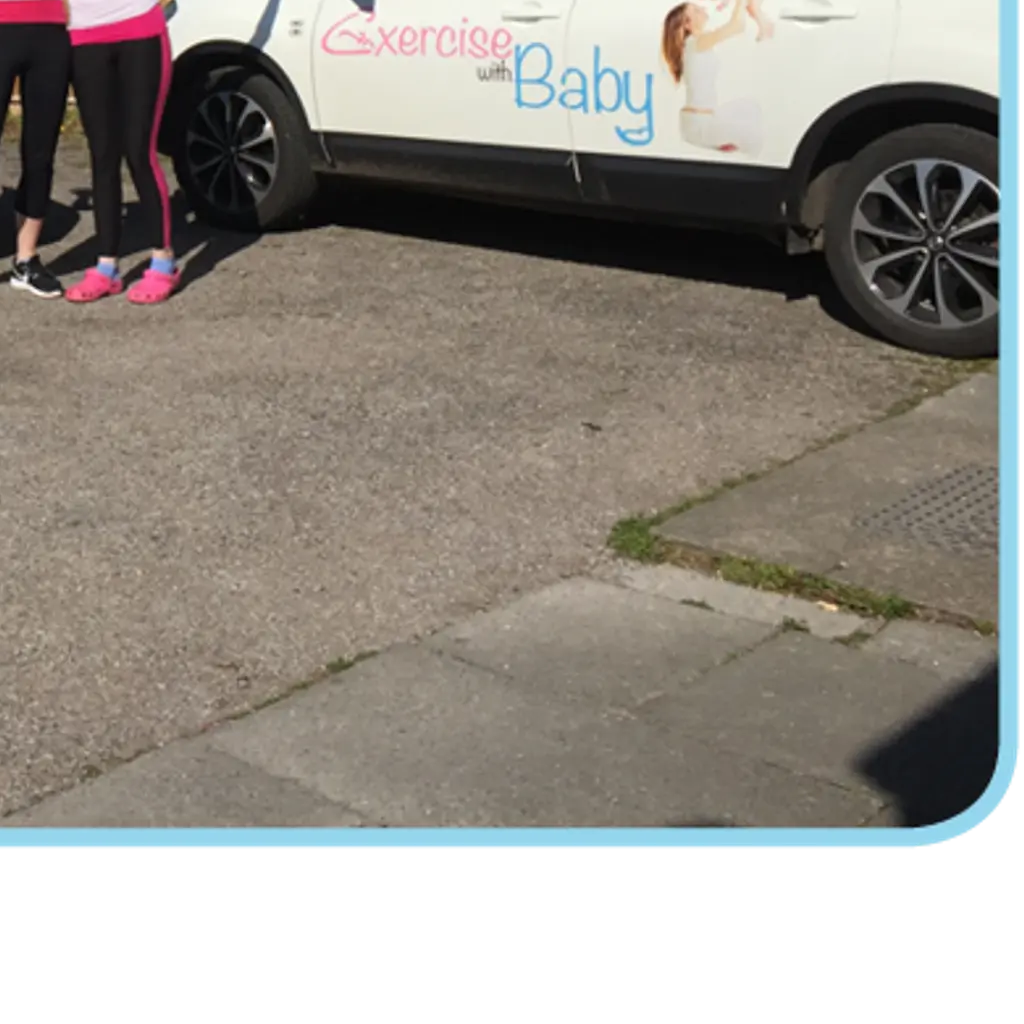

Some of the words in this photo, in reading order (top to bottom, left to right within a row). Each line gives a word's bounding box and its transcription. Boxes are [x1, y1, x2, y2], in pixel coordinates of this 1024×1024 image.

[320, 11, 513, 59] Exercise
[477, 59, 513, 83] with
[514, 43, 655, 146] Baby
